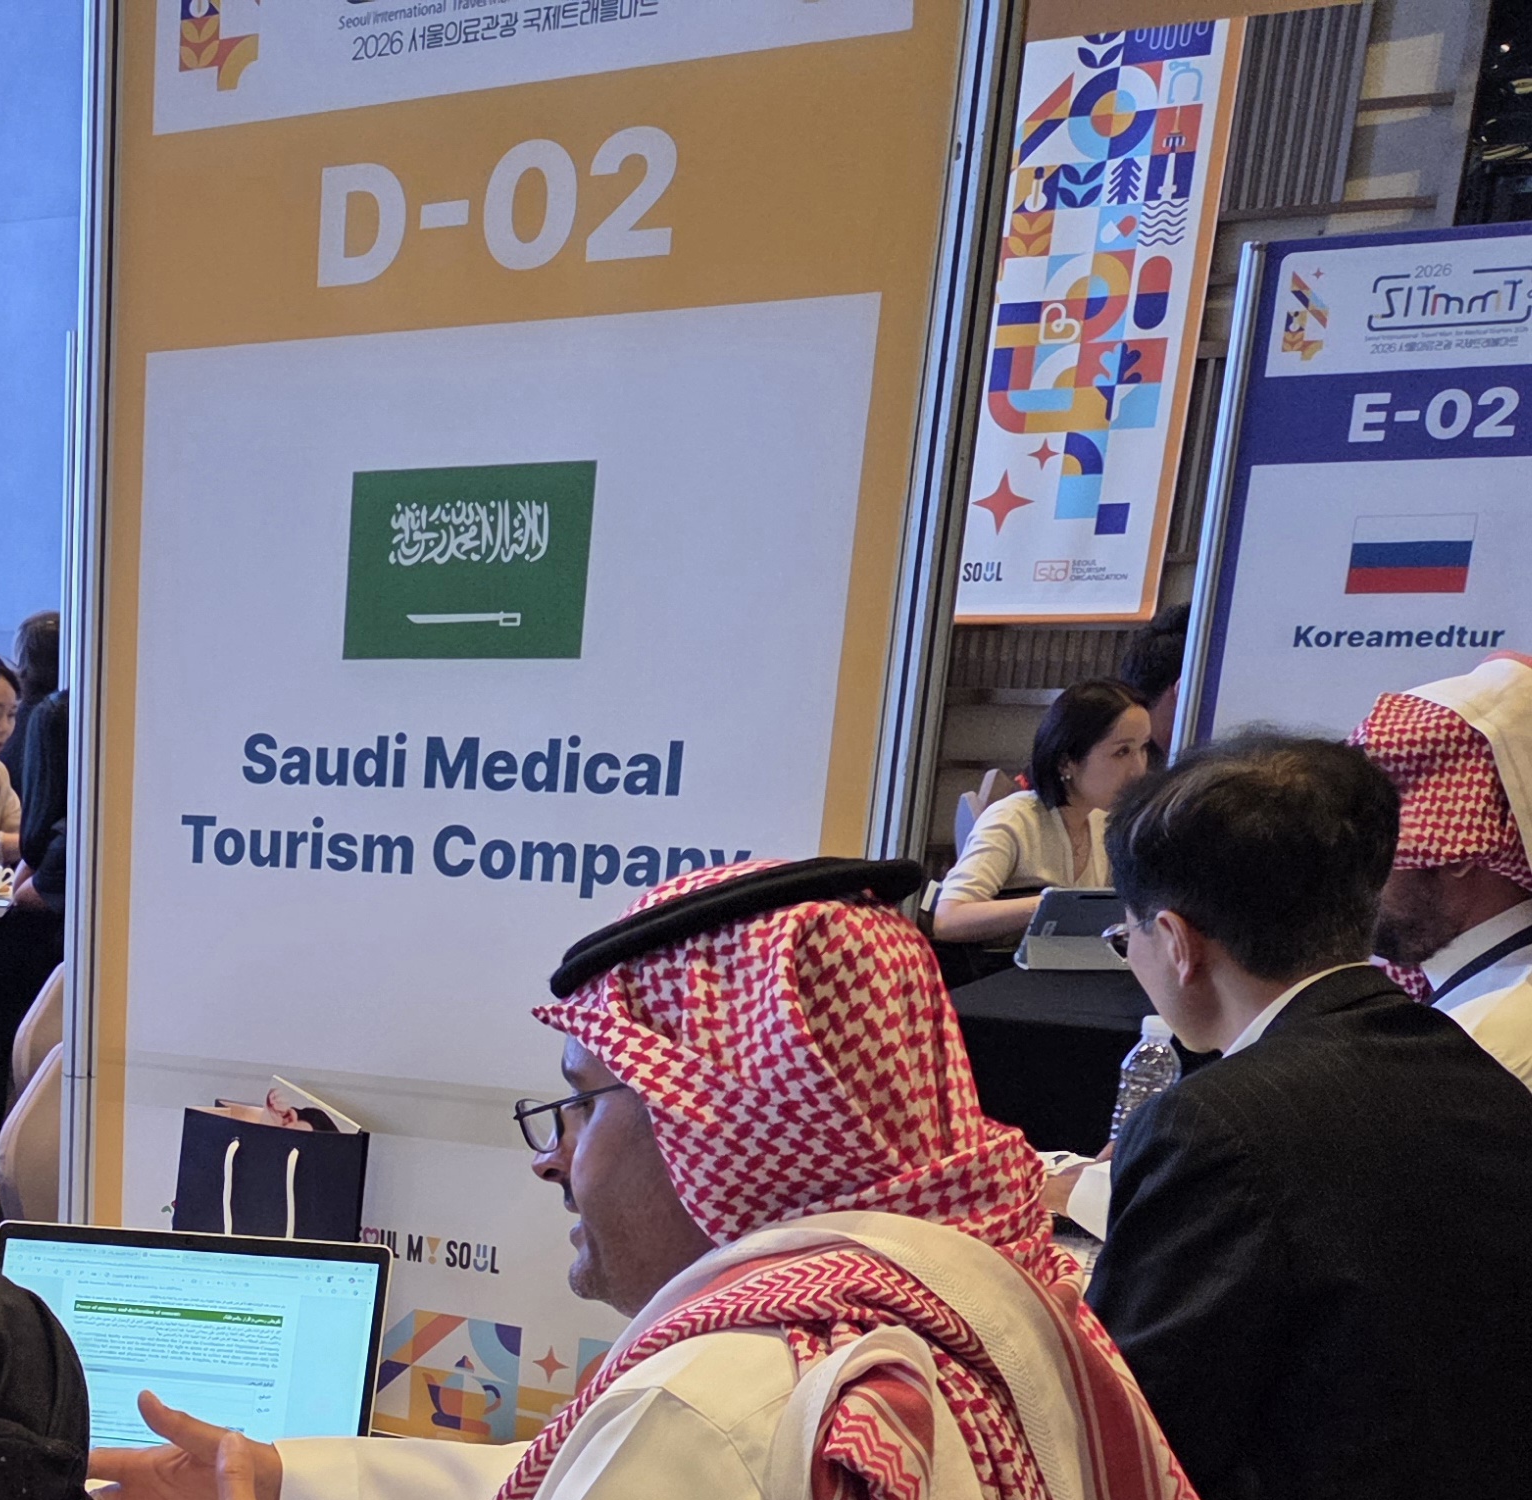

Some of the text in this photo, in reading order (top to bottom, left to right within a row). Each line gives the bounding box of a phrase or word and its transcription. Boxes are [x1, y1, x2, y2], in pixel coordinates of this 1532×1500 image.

[338, 11, 370, 30] Seoul
[372, 1, 447, 25] International
[352, 0, 658, 60] 2026 서울의료관광 국제트래블마트
[317, 126, 679, 287] D-02
[1414, 263, 1453, 279] 2026
[1347, 386, 1520, 443] E-02
[962, 561, 1003, 582] SOUL
[1069, 573, 1129, 581] ORGANIZATION
[1071, 559, 1097, 567] SEOUL
[1293, 624, 1505, 649] Koreamedtur
[242, 732, 685, 796] Saudi Medical
[180, 814, 415, 875] Tourism
[445, 1240, 500, 1274] SOUL
